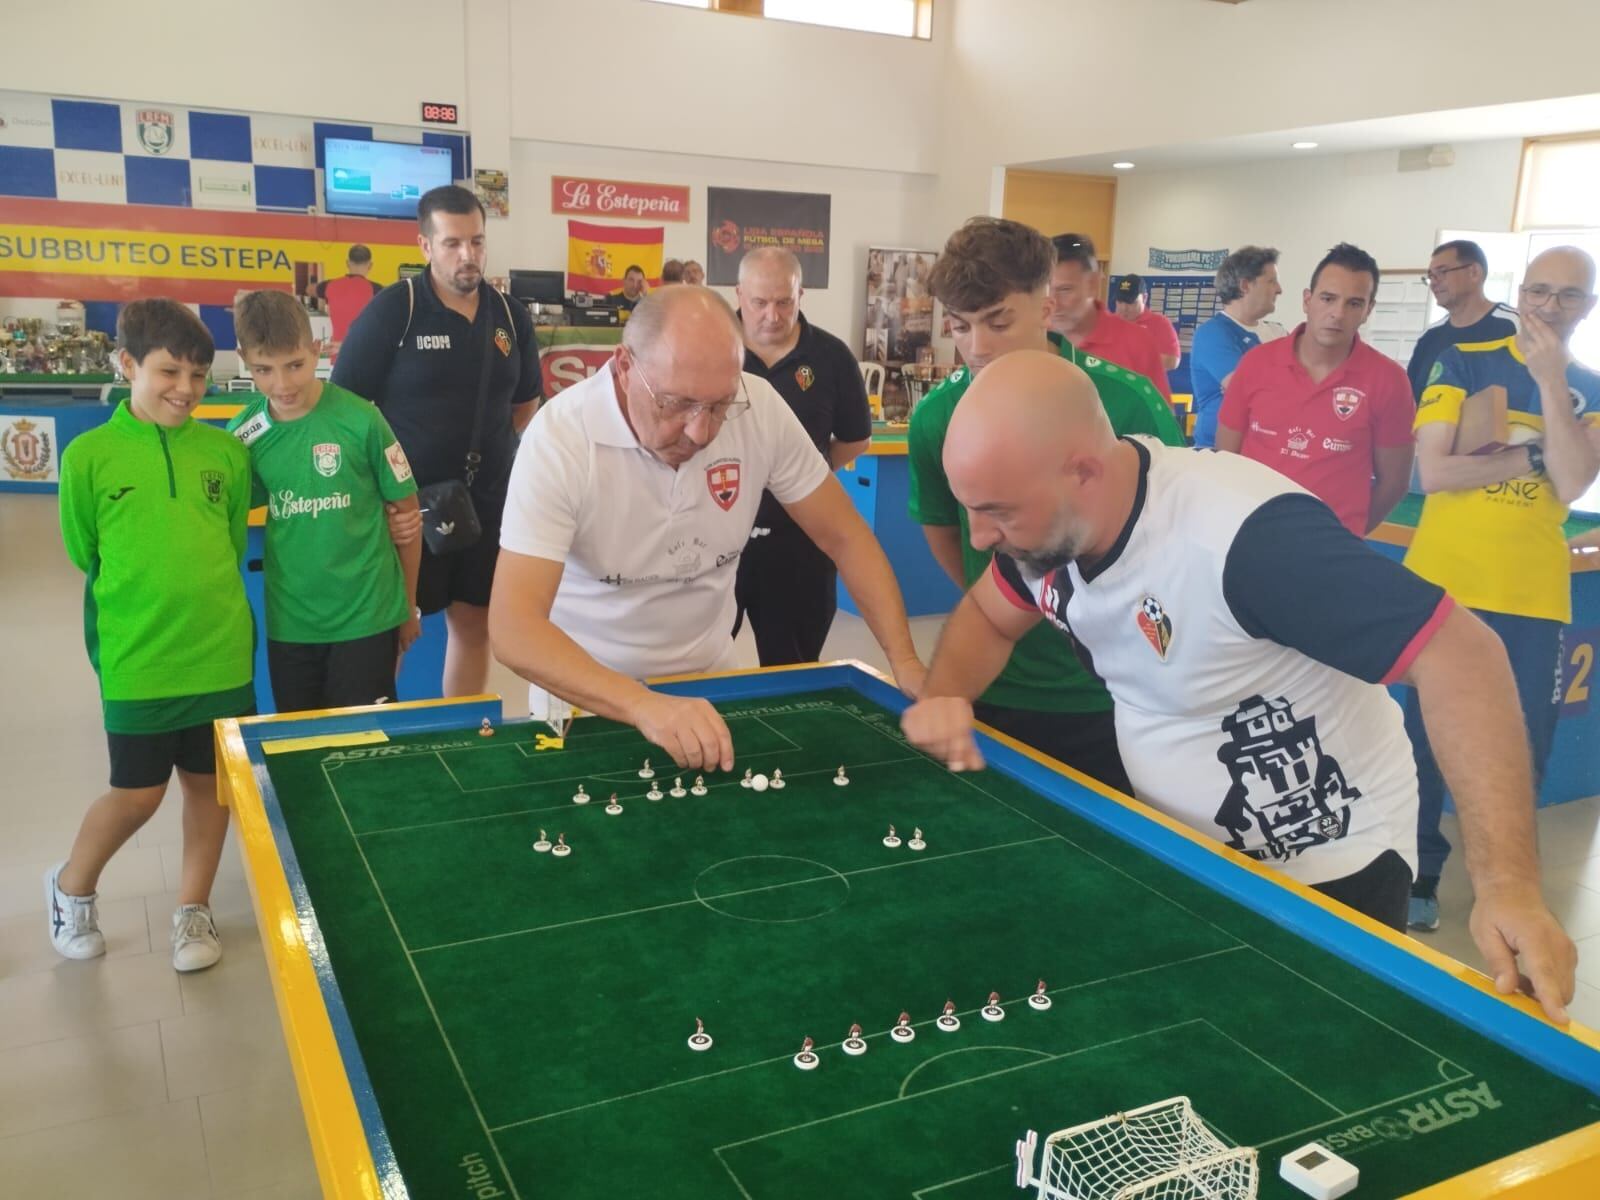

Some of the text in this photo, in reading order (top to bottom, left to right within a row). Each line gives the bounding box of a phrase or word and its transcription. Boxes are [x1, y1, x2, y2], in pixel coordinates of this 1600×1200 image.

[562, 180, 680, 216] La Estepeña
[0, 235, 292, 271] SUBBUTEO ESTEPA
[278, 489, 351, 519] Estepeña
[1564, 643, 1594, 704] 2
[458, 1152, 507, 1200] pitch
